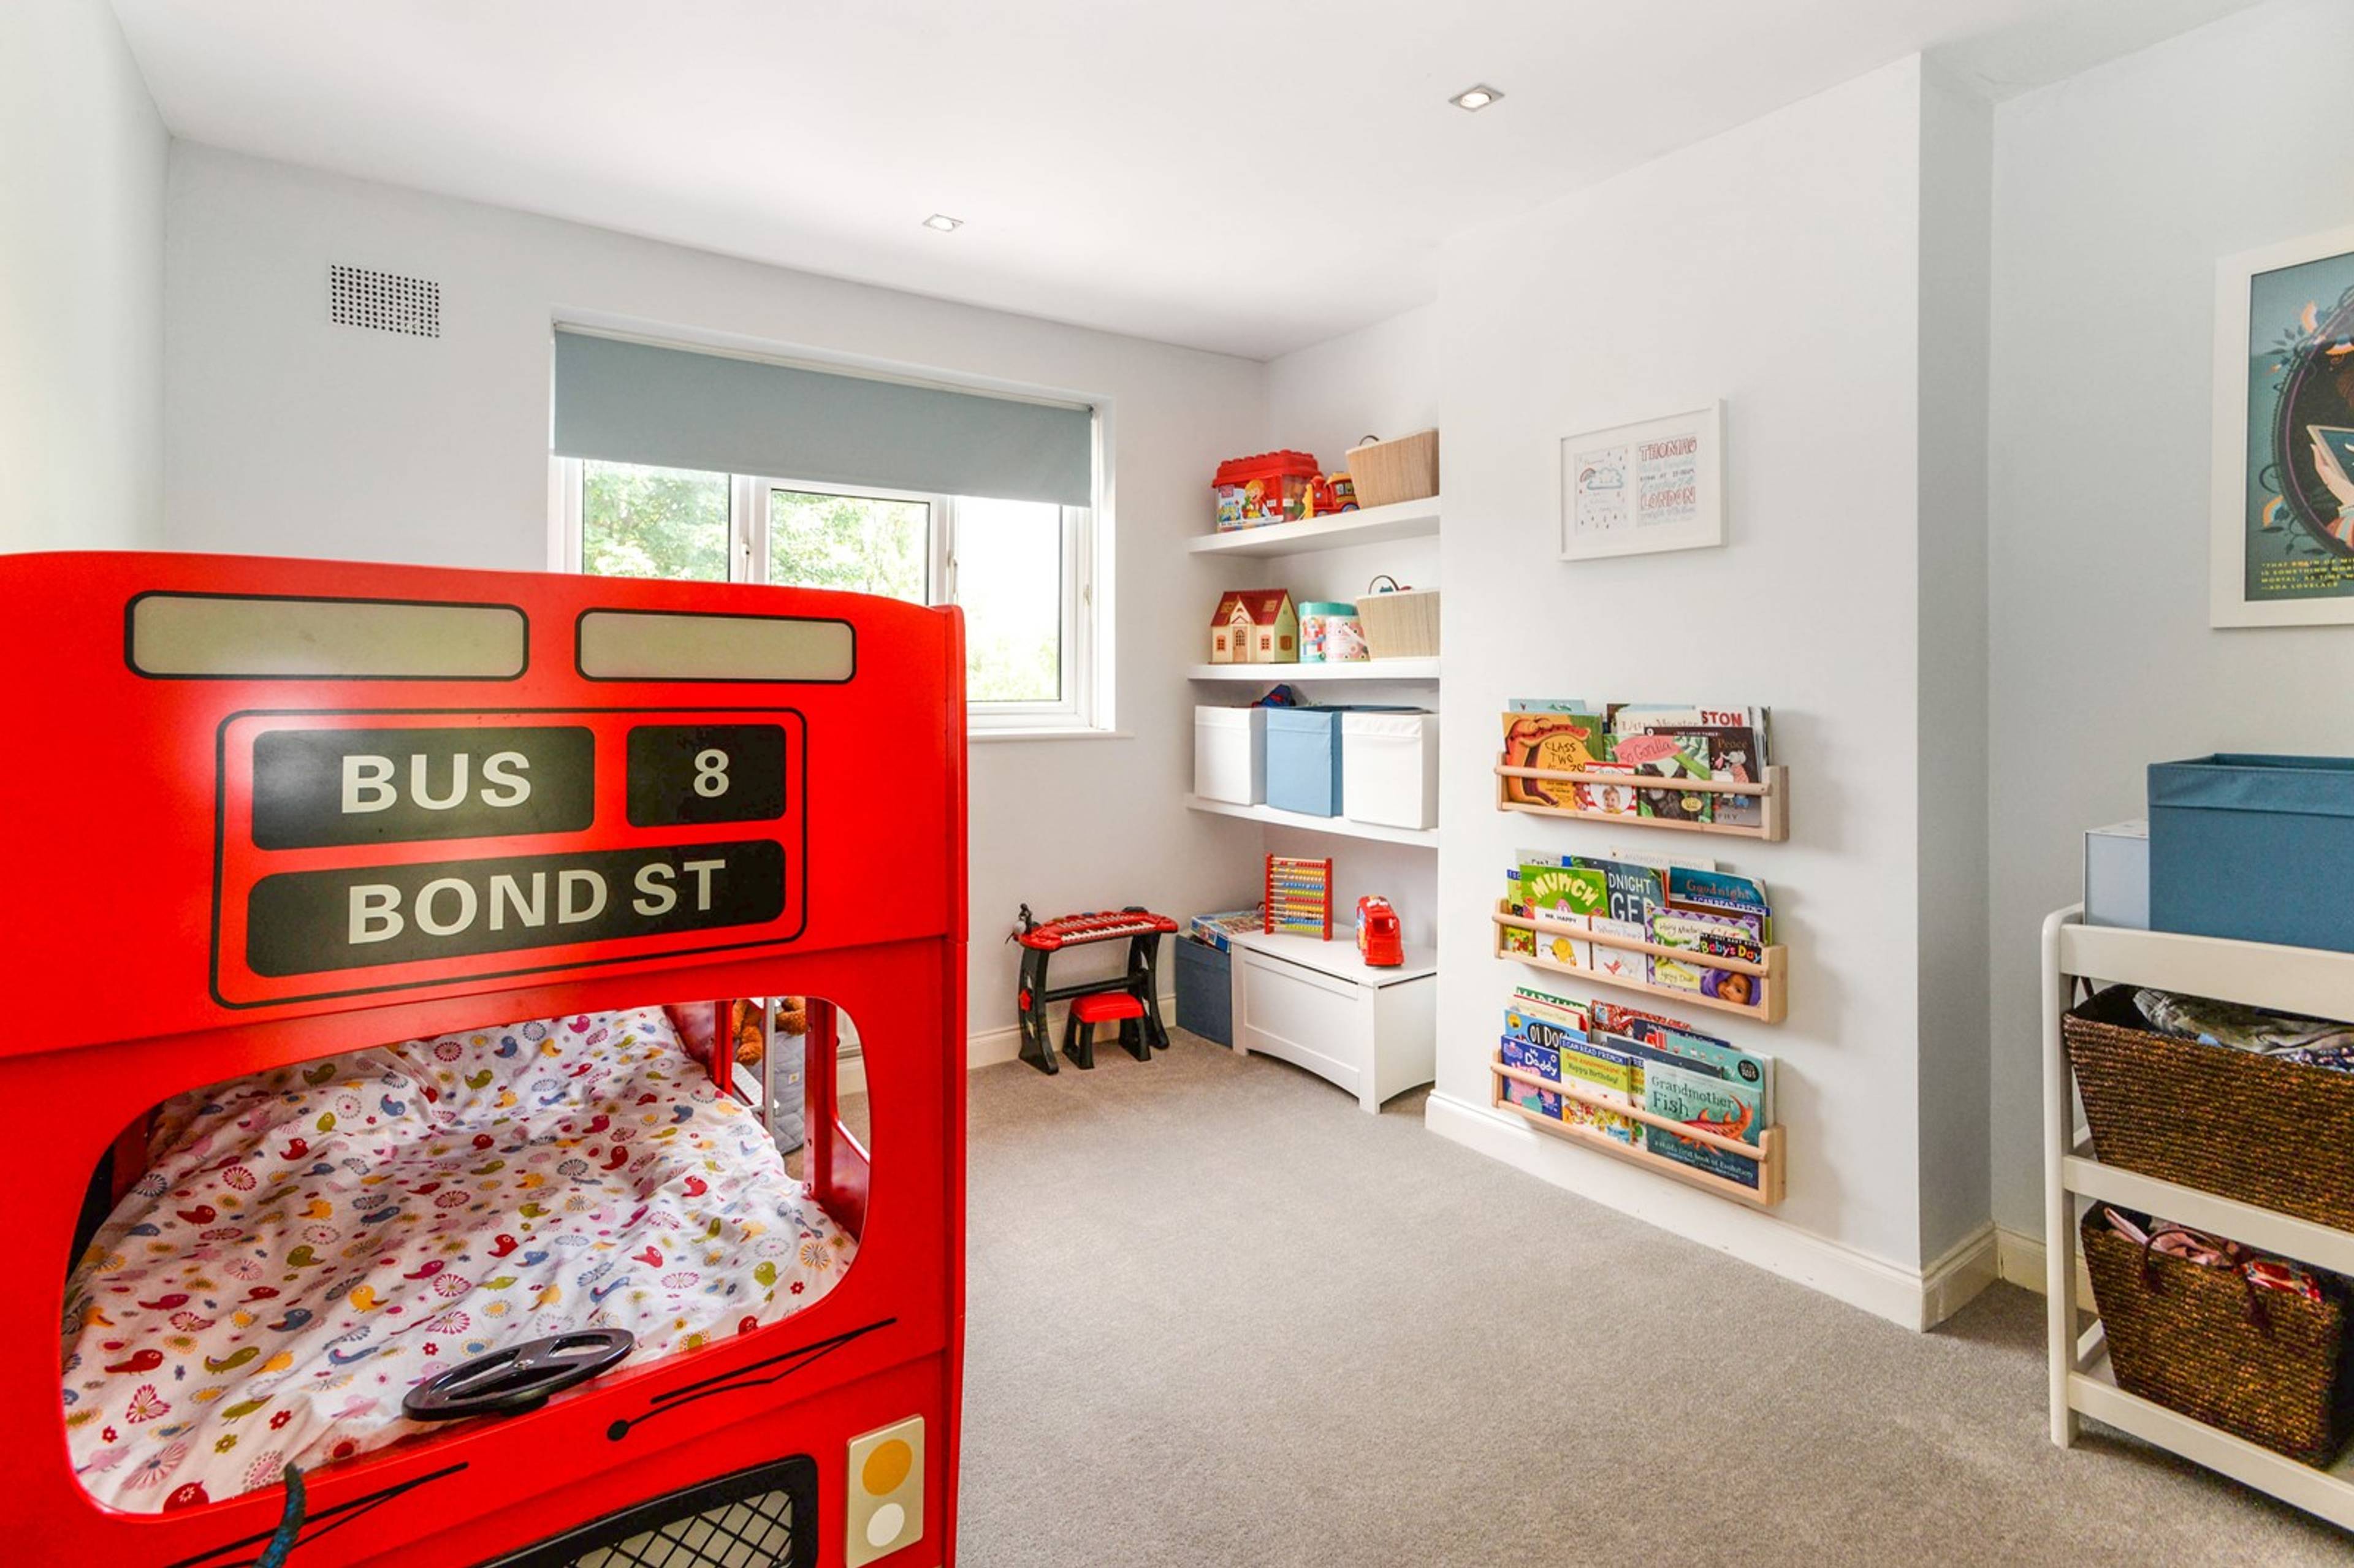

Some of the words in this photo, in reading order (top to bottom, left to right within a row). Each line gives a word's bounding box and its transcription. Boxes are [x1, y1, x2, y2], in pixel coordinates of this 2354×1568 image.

[1545, 742, 1576, 755] CLASS
[1550, 752, 1574, 764] TWO
[340, 751, 531, 814] BUS
[693, 748, 730, 798] 8
[348, 869, 608, 945] BOND
[631, 859, 726, 917] ST
[1531, 872, 1599, 906] MUNCH
[1686, 880, 1750, 901] Goodnight
[1700, 941, 1736, 957] Baby's
[1738, 945, 1762, 963] Day
[1524, 1052, 1558, 1076] Daddy
[1651, 1076, 1735, 1109] Grandmother
[1653, 1091, 1689, 1117] Fish
